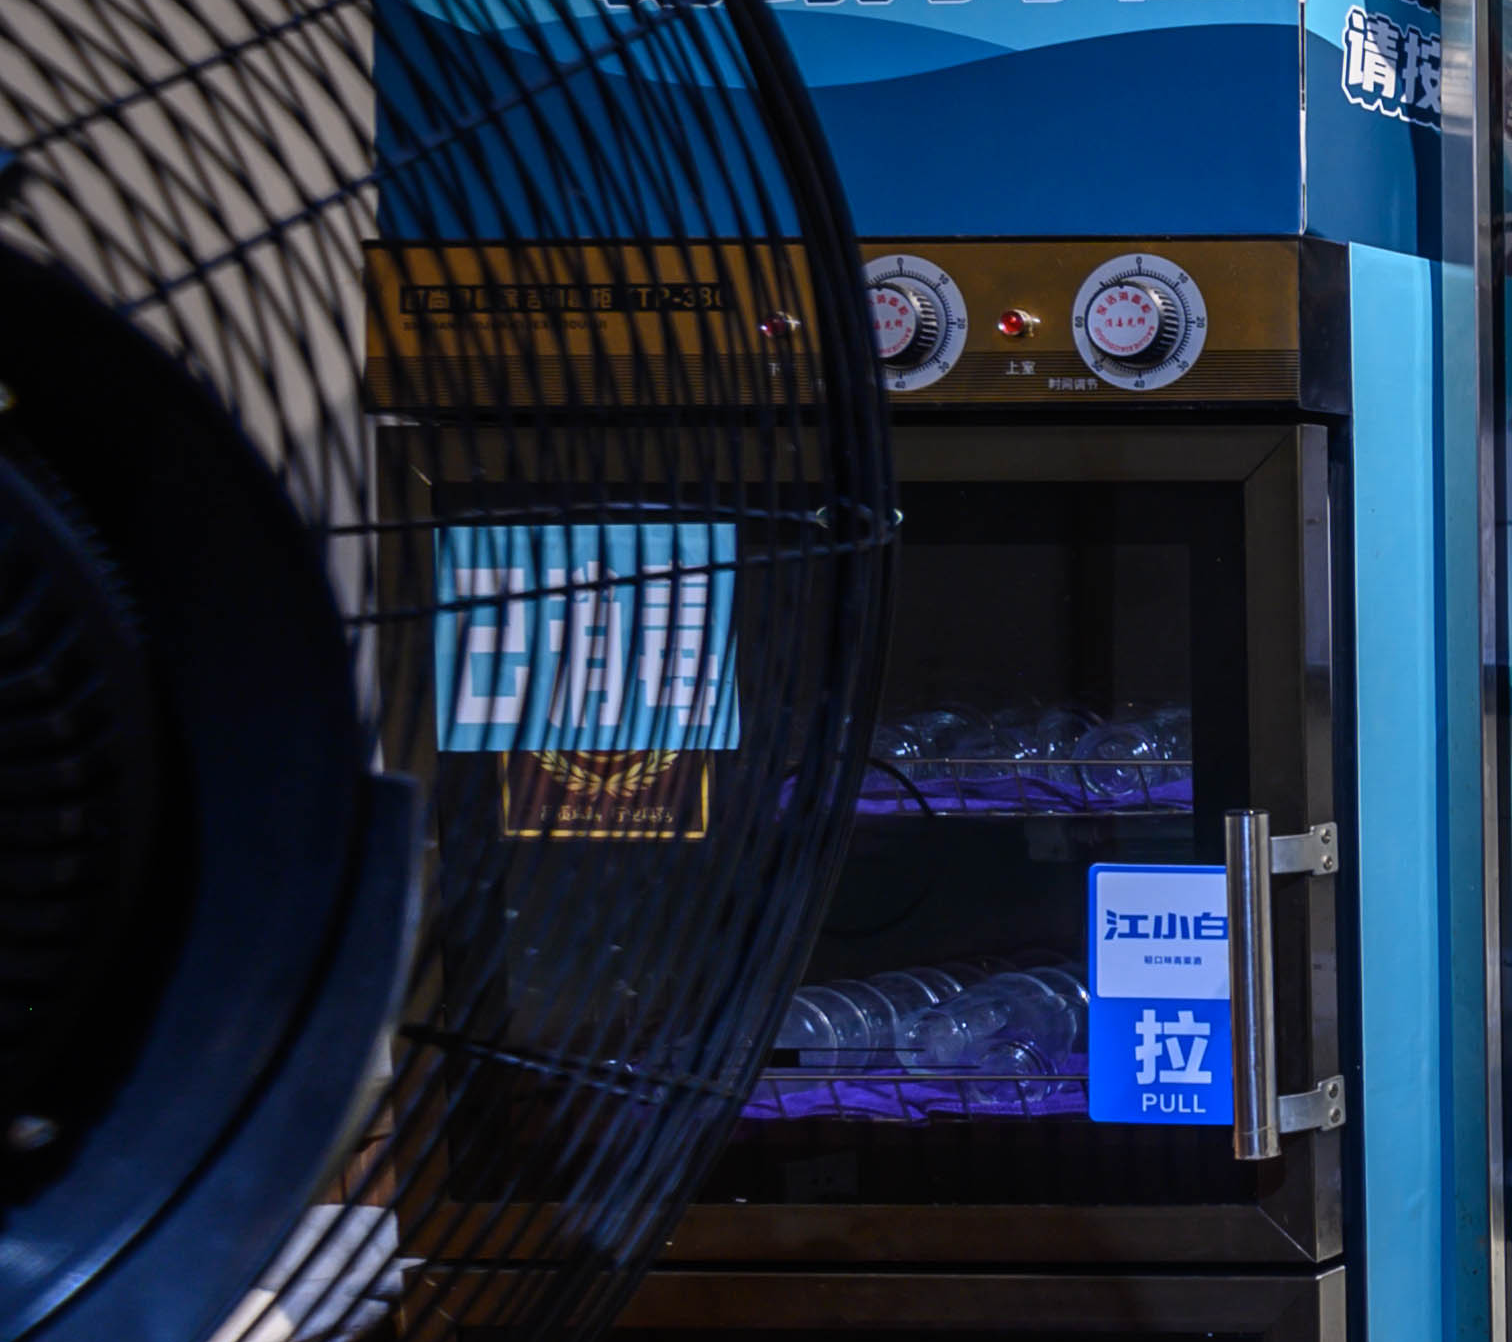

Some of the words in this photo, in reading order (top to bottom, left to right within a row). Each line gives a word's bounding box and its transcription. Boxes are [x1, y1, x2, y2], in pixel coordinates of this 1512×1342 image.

[1104, 909, 1229, 941] 江小白
[1135, 1008, 1212, 1086] 拉
[1141, 1092, 1206, 1114] PULL
